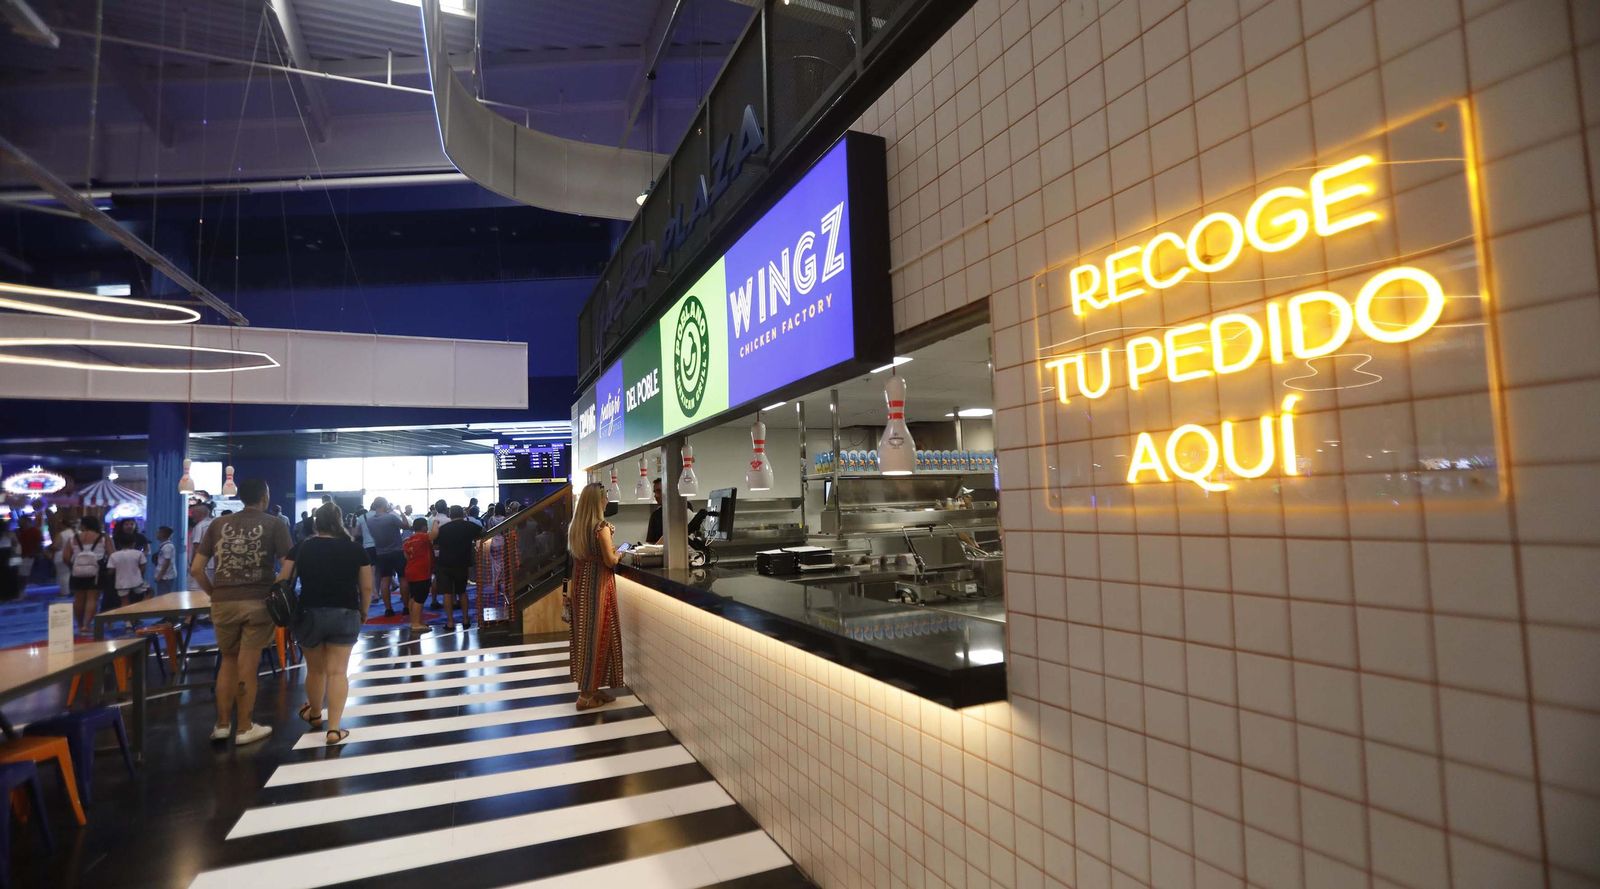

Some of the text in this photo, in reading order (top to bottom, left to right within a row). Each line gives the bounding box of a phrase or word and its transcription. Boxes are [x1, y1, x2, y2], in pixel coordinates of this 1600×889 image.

[662, 104, 765, 258] PLAZA
[729, 200, 845, 339] WINGZ
[1068, 153, 1385, 317] RECOGE
[675, 301, 706, 355] POBLANO
[739, 293, 833, 358] CHICKEN FACTORY
[1044, 266, 1446, 404] TU PEDIDO
[626, 368, 660, 413] DEL POBLE
[676, 359, 707, 411] MEXICAN GRILL
[1126, 392, 1303, 493] AQUÍ
